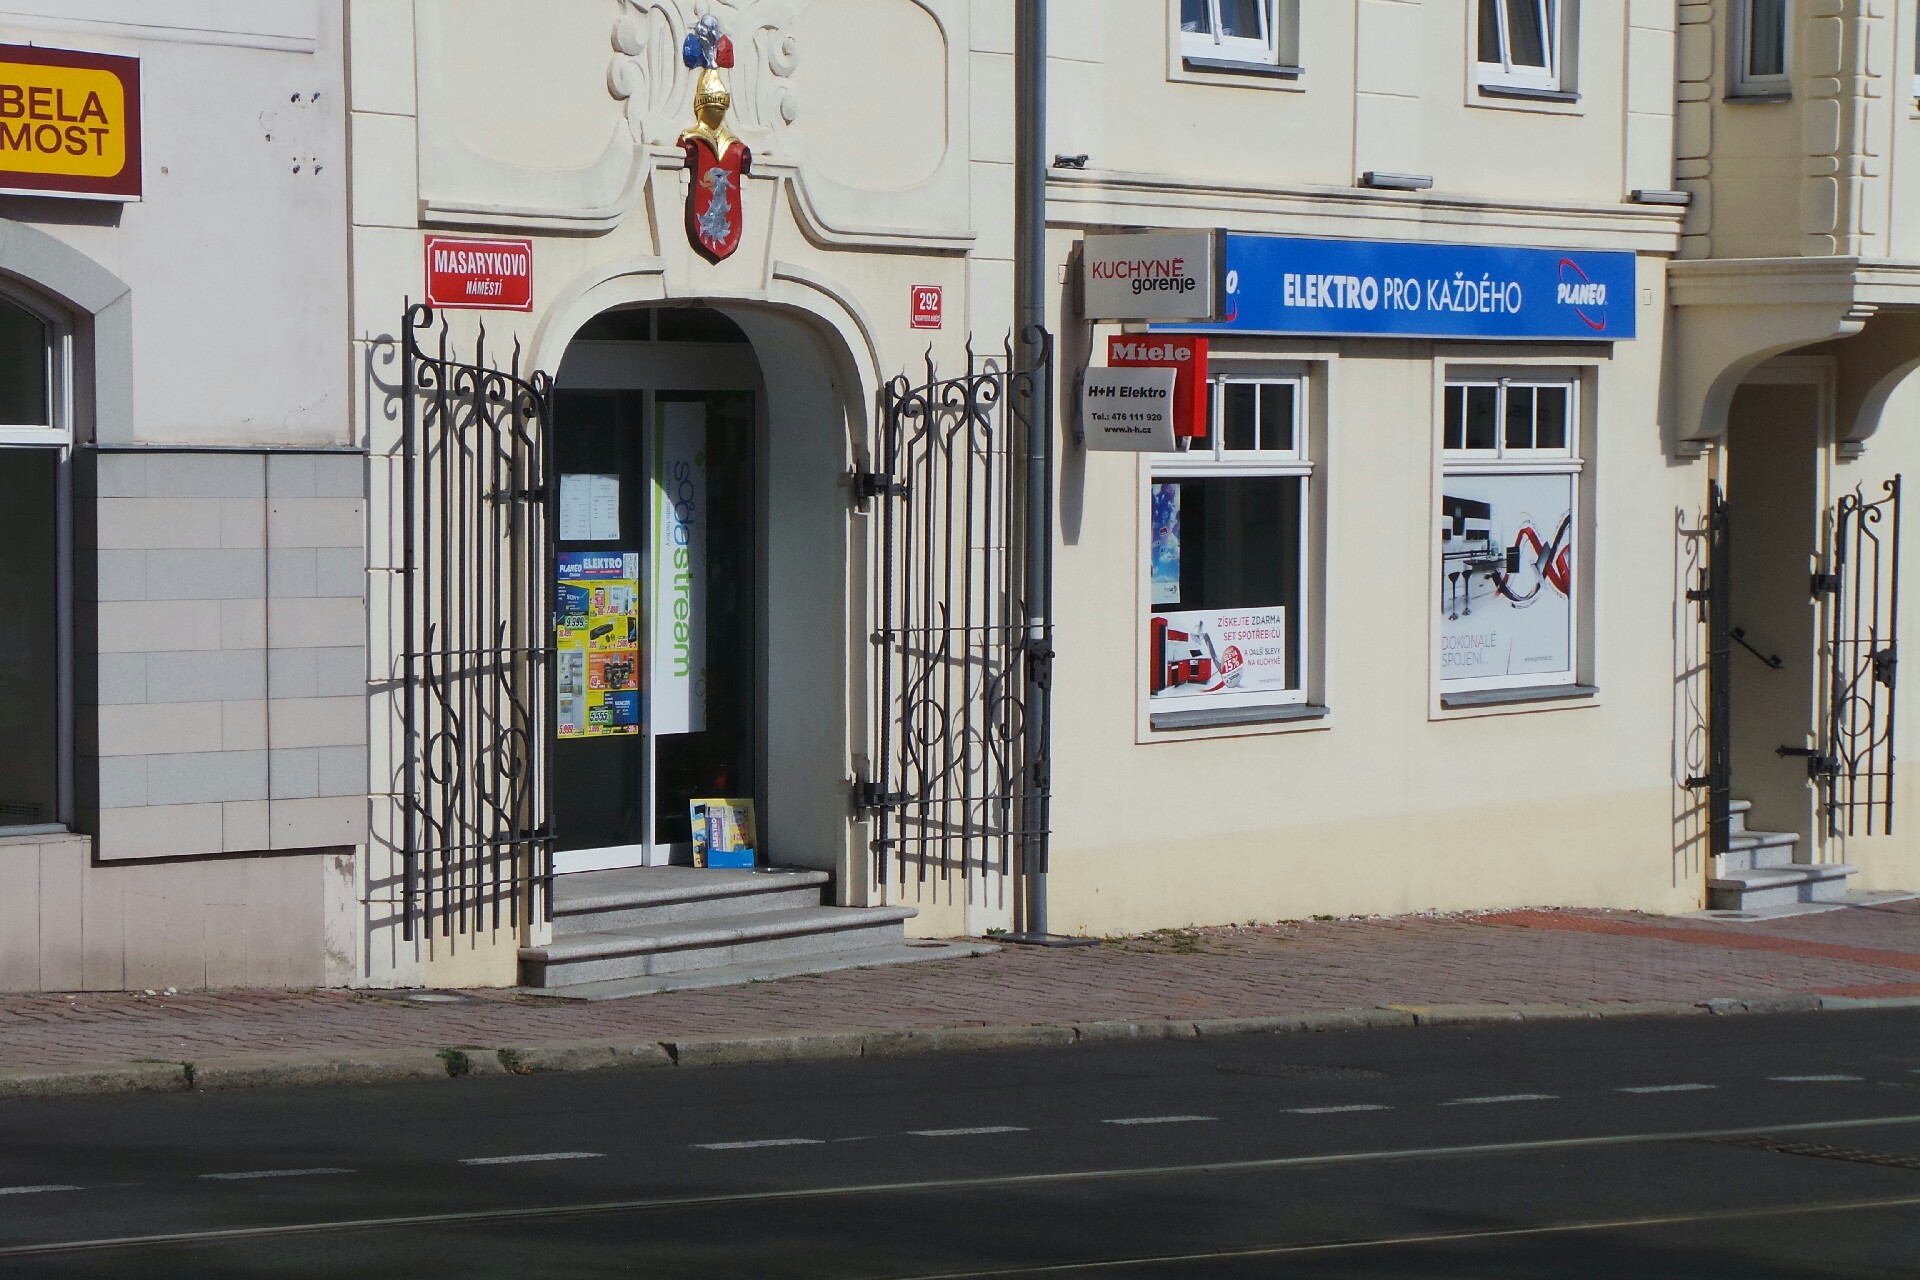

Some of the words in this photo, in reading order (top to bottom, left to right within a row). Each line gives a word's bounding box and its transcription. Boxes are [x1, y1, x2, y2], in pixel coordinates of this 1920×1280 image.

[0, 122, 110, 156] MOST
[434, 250, 526, 277] MASARYKOVO
[1092, 257, 1184, 279] KUCHYNĚ
[465, 277, 503, 296] NÁMĚSTÍ
[1132, 274, 1195, 294] gorenje
[1283, 273, 1379, 310] ELEKTRO
[1383, 277, 1421, 311] PRO
[1426, 271, 1522, 314] KAŽDÉHO
[919, 292, 938, 310] 292
[1557, 283, 1606, 306] PLANEO
[1111, 342, 1191, 361] Miele
[1088, 386, 1115, 397] H+H
[1119, 386, 1167, 398] Elektro
[1091, 412, 1110, 421] Tel.:
[1111, 412, 1127, 421] 476
[1129, 413, 1144, 421] 111
[1146, 413, 1162, 421] 920
[1103, 426, 1152, 434] www.h-h.cz
[582, 557, 622, 569] ELEKTRO
[1217, 616, 1250, 627] ZÍSKEJTE
[1251, 615, 1280, 626] ZDARMA
[1223, 631, 1236, 641] SET
[1238, 626, 1281, 641] SPOTŘEBIČŮ
[1441, 630, 1496, 651] DOKONALÉ
[1248, 658, 1256, 666] NA
[1256, 655, 1281, 665] KUCHYNĚ
[1265, 647, 1281, 656] SLEVY
[1224, 656, 1240, 672] 15%
[711, 818, 719, 848] ELEKTRO
